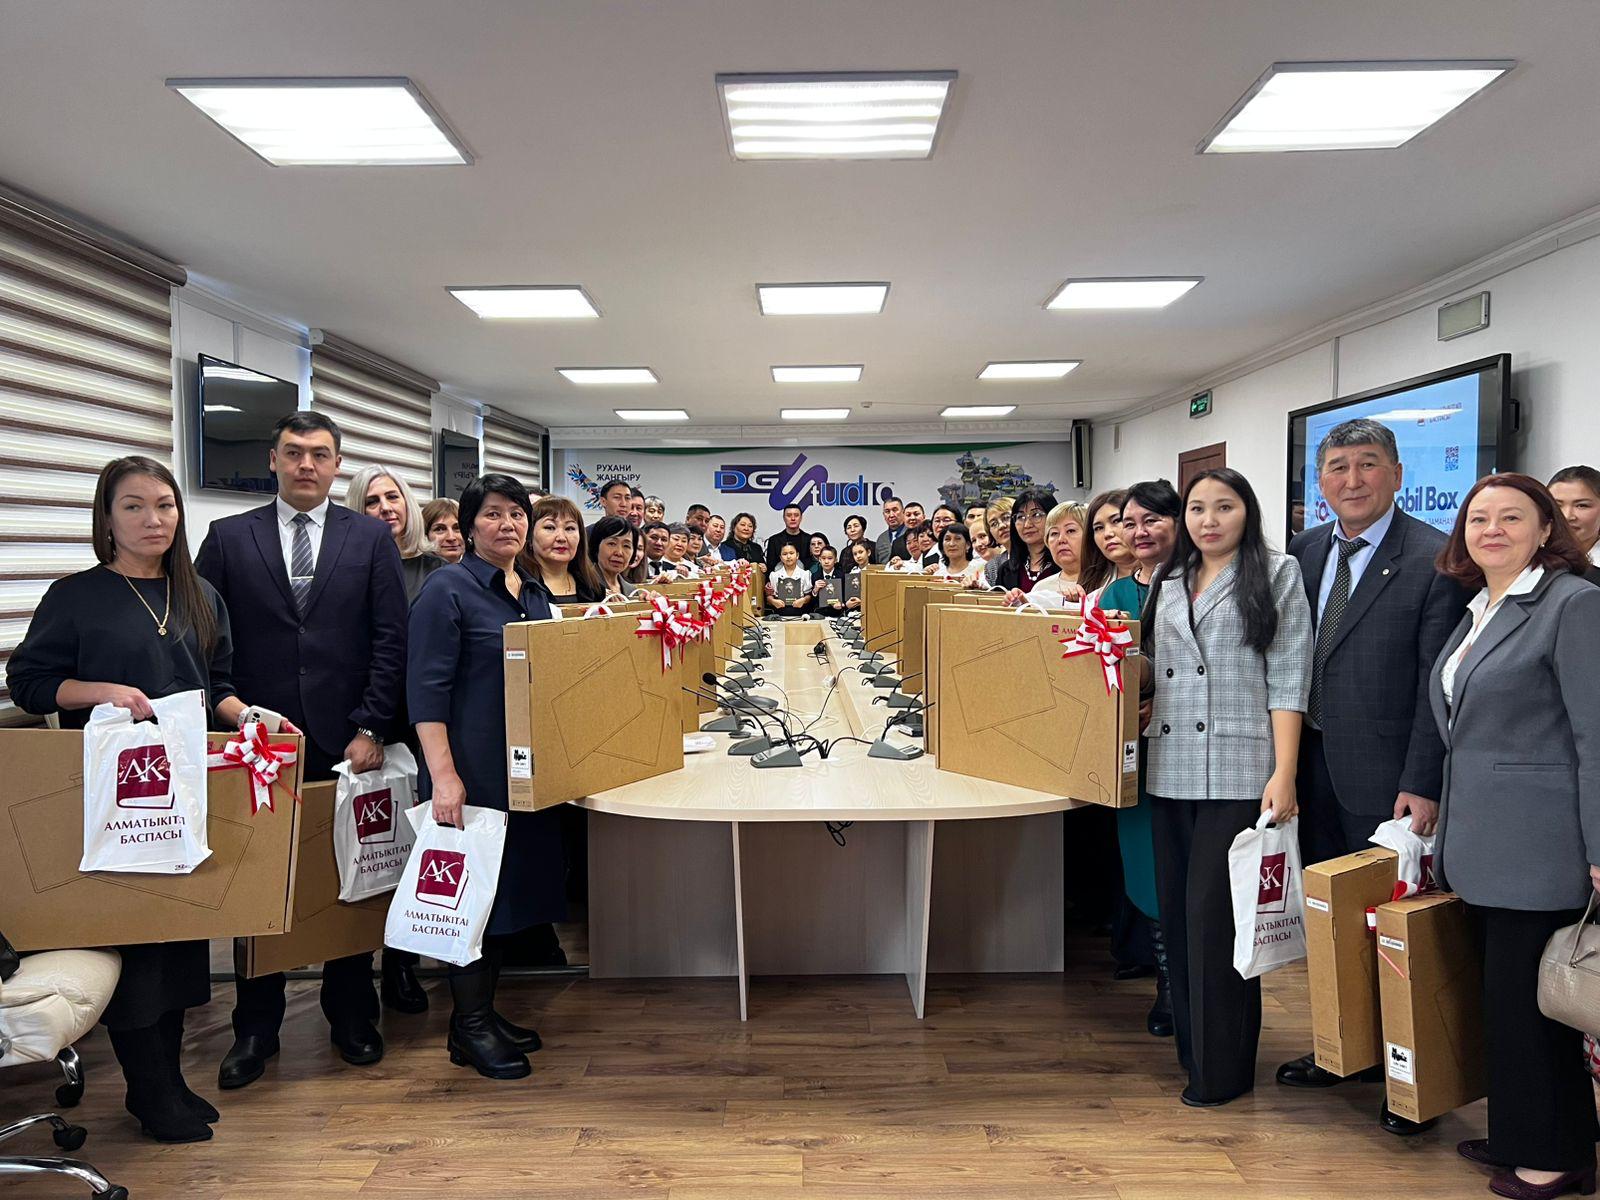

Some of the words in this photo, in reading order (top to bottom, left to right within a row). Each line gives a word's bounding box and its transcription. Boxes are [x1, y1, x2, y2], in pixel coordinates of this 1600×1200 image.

[596, 464, 632, 472] РУХАНИ
[1396, 486, 1422, 512] obil
[1425, 486, 1459, 511] Box
[120, 829, 182, 845] БАСПАСЫ
[360, 858, 403, 874] БАСПАСЫ
[411, 923, 460, 937] БАСПАСЫ
